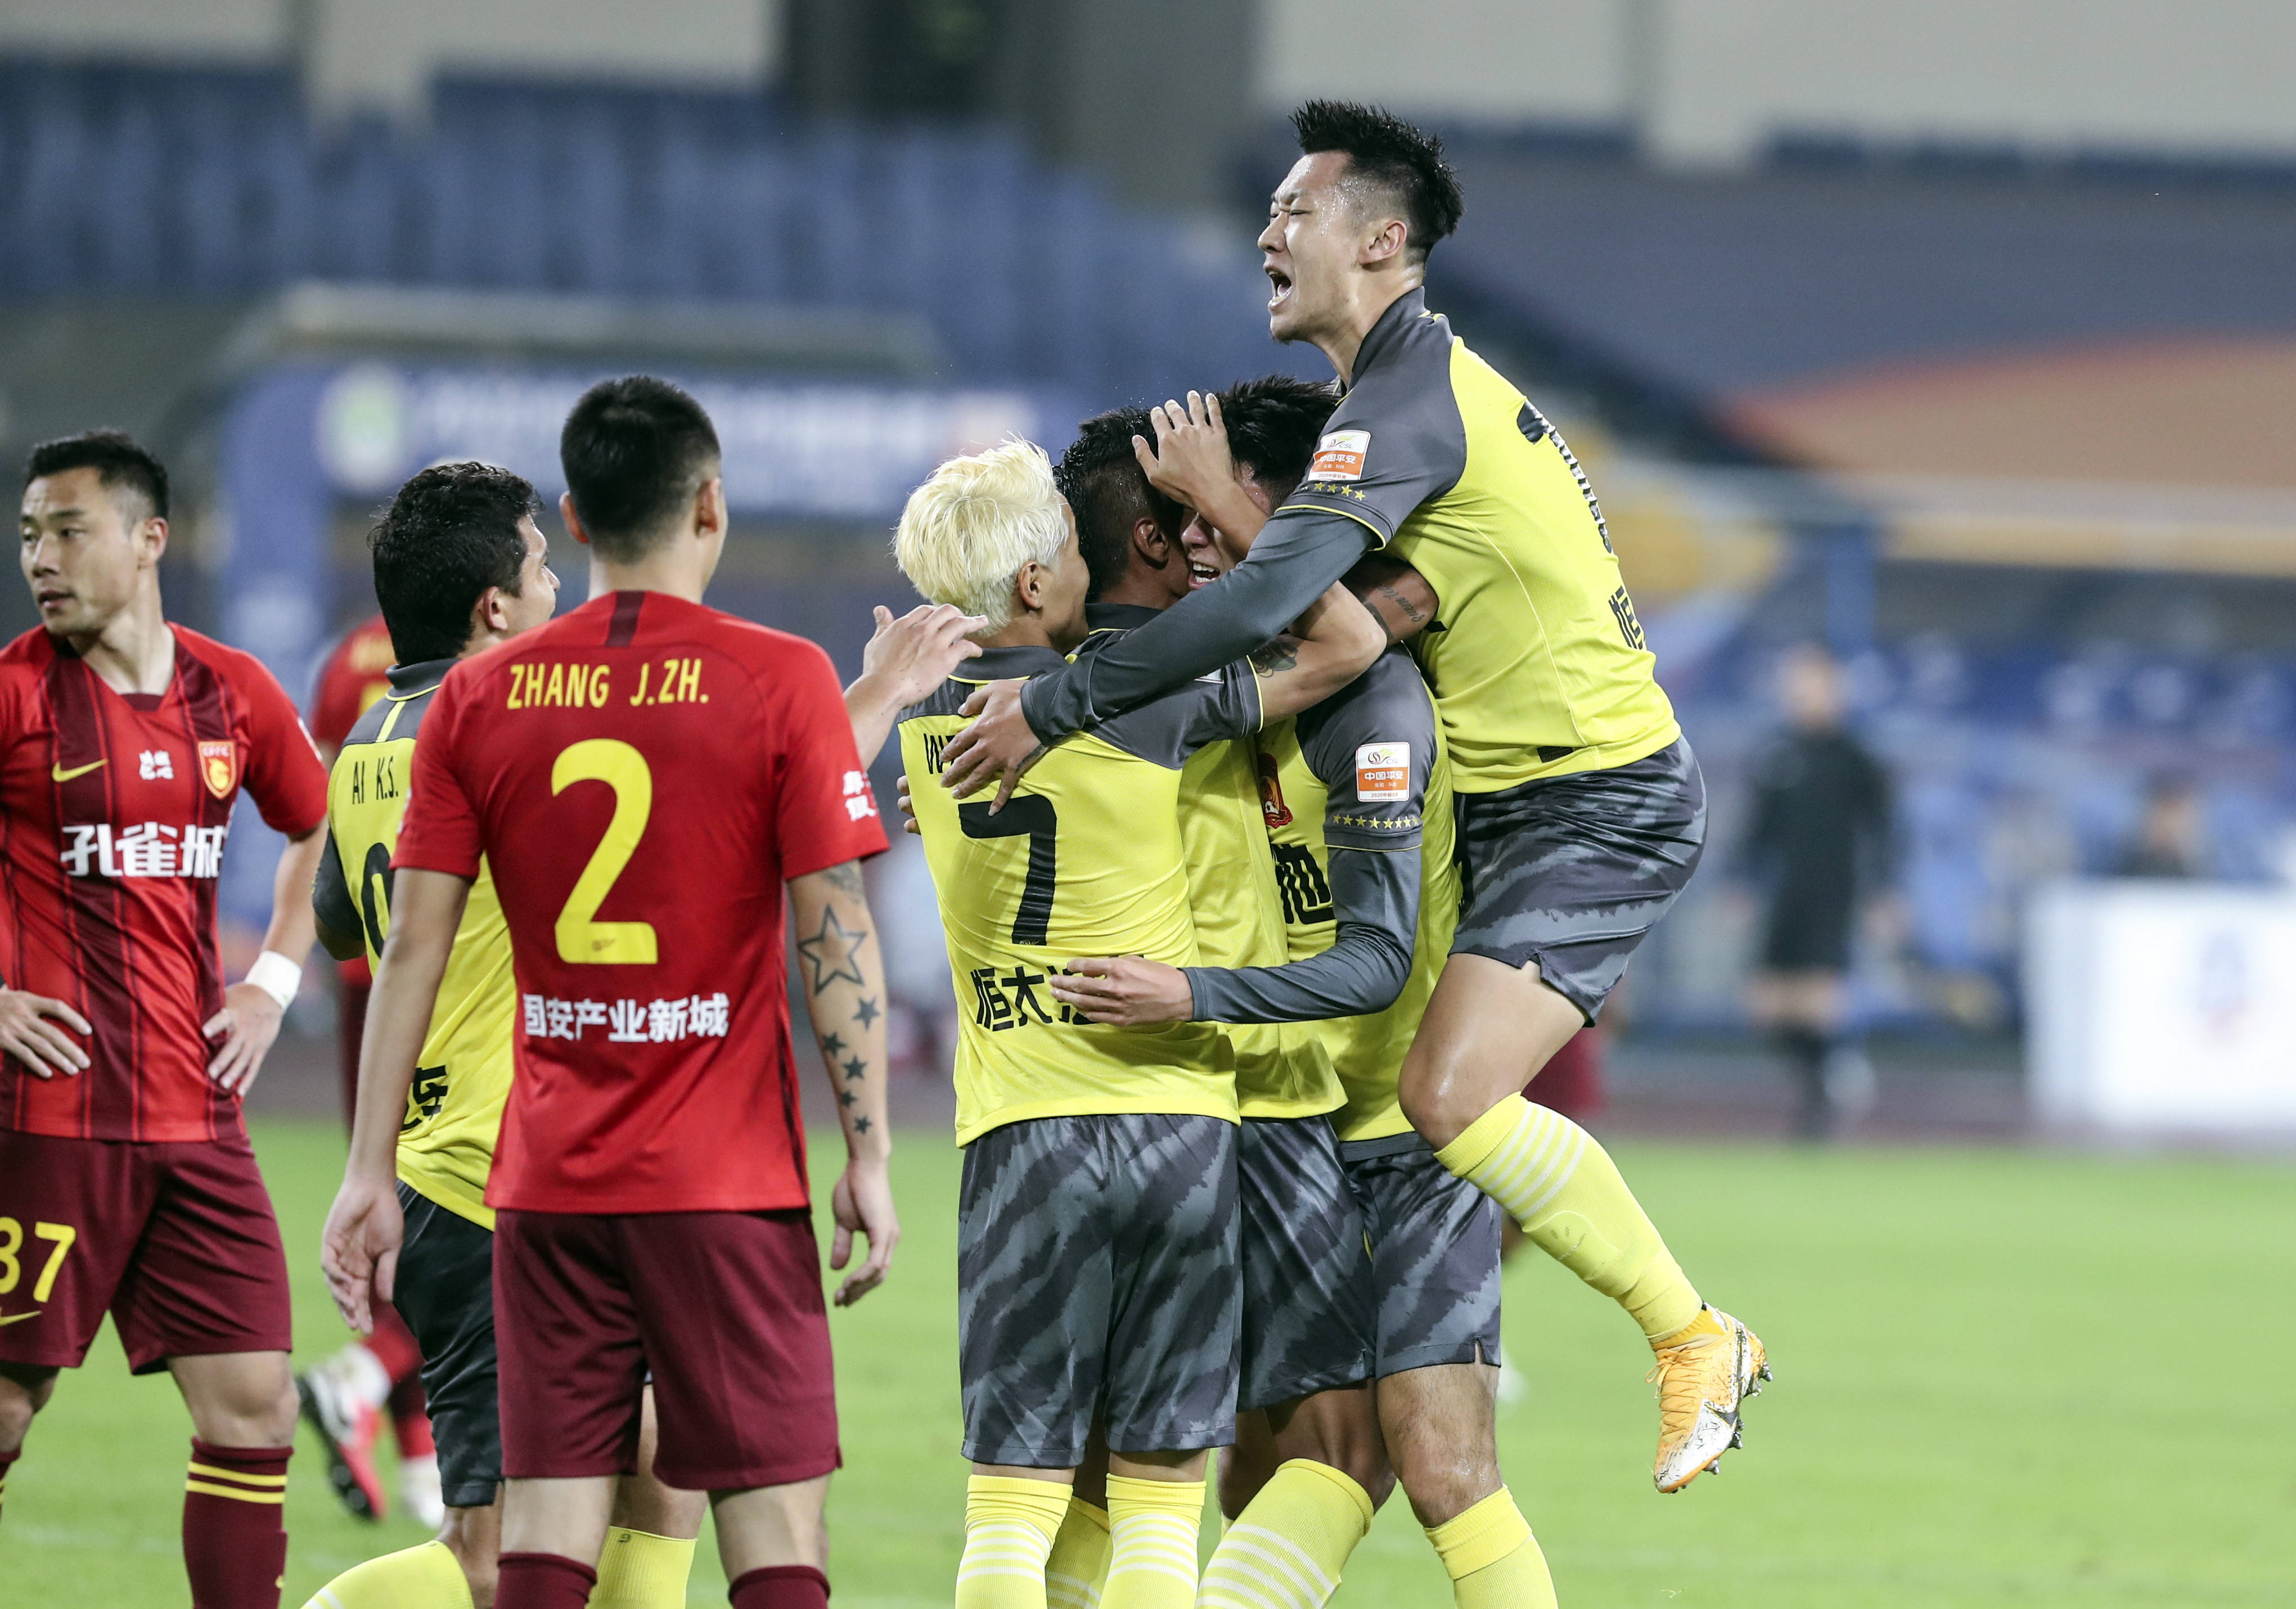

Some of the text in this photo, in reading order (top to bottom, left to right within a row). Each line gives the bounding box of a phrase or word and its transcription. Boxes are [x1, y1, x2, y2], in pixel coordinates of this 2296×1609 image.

[1320, 453, 1356, 464] 中国平安
[507, 657, 710, 710] ZHANG J.ZH.
[352, 755, 399, 805] AI K.S.
[1364, 771, 1403, 781] 中国平安
[60, 821, 226, 878] 孔雀城
[551, 738, 659, 965] 2
[958, 794, 1057, 945] 7
[523, 992, 730, 1043] 固安产业新城
[970, 965, 1100, 1031] 恒大
